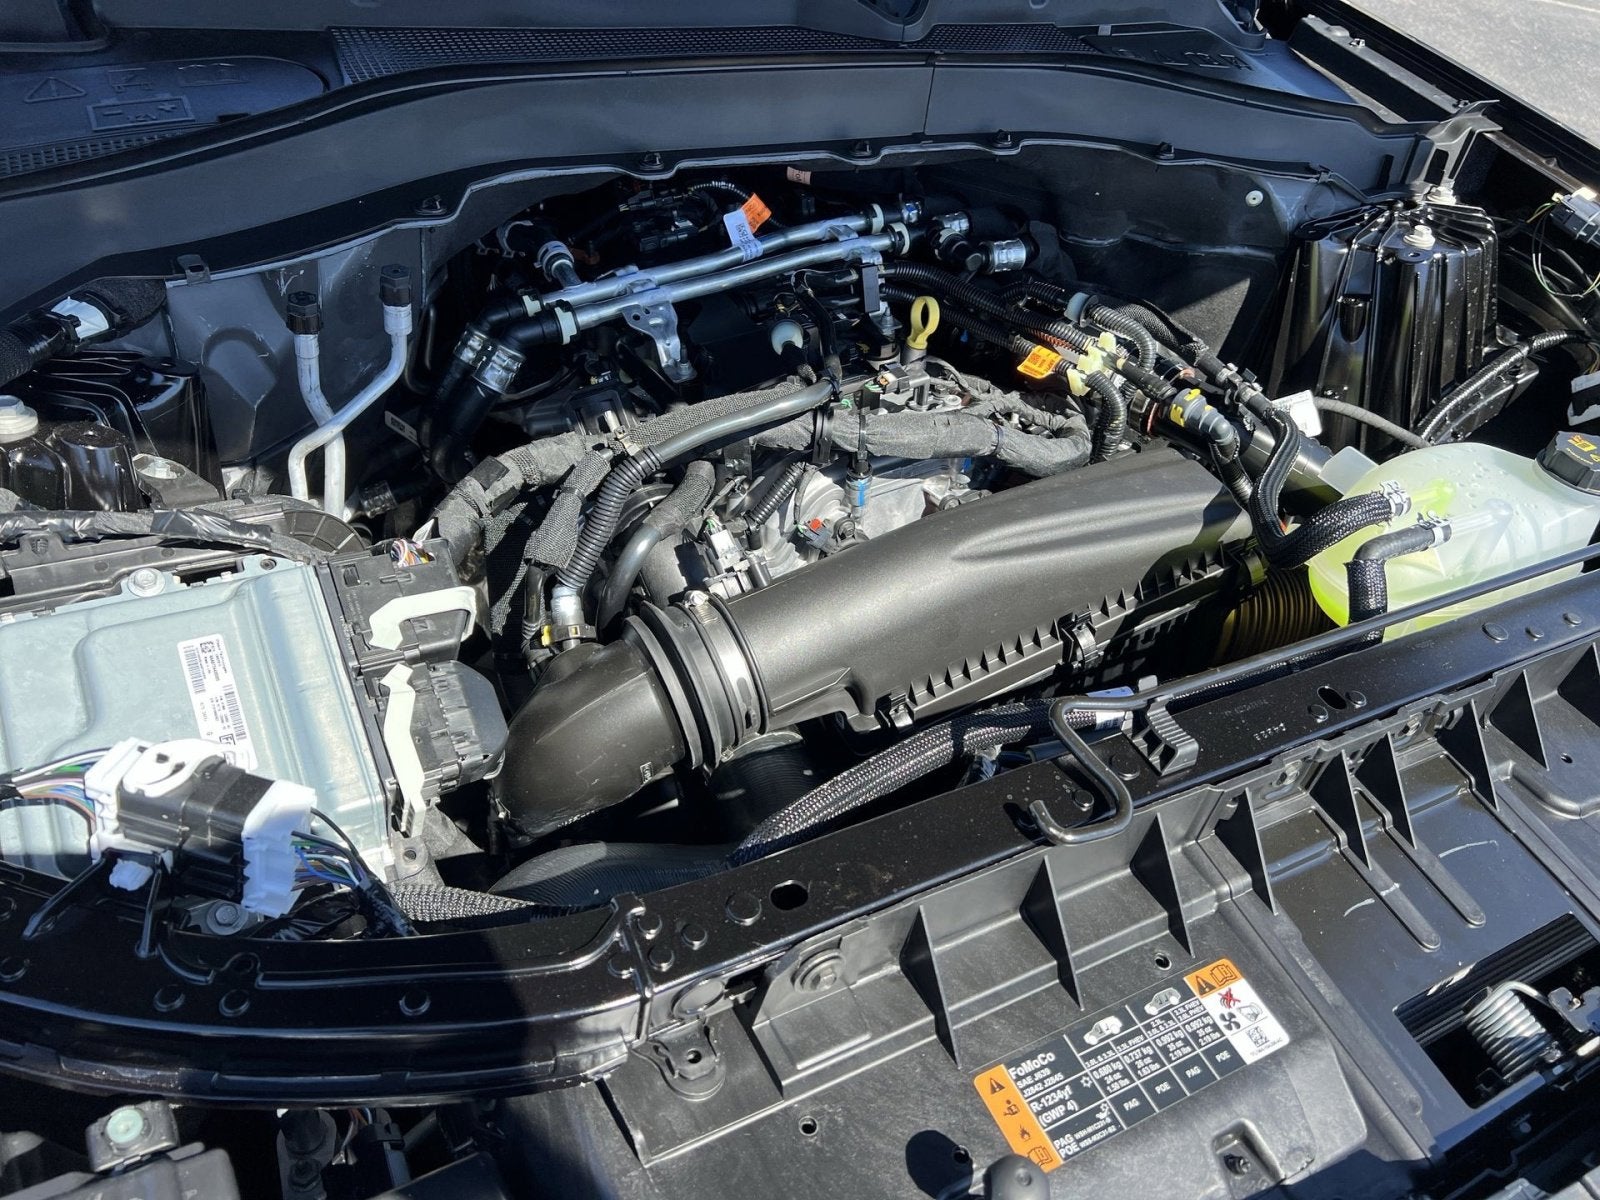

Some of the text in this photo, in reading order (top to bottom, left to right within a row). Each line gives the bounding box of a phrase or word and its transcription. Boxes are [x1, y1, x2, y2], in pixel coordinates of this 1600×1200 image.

[1185, 1016, 1214, 1032] 0.992 kg
[1155, 1030, 1185, 1047] 0.992 kg
[1196, 1028, 1205, 1037] 35
[1209, 1032, 1221, 1040] lbs
[1167, 1043, 1176, 1051] 35
[1180, 1046, 1192, 1054] lbs
[1123, 1046, 1154, 1064] 0.737 kg
[1215, 1050, 1231, 1062] POE
[1008, 1052, 1055, 1080] FoMoCo
[1092, 1061, 1124, 1079] 0.680 kg
[1135, 1057, 1153, 1069] 26 oz
[1138, 1063, 1160, 1077] 1.63 lbs
[1017, 1068, 1051, 1088] SAE J639
[1104, 1072, 1122, 1084] 24 oz
[1185, 1066, 1201, 1078] PAG
[1023, 1072, 1064, 1097] J2842 J2845
[1118, 1078, 1130, 1087] lbs
[1155, 1082, 1171, 1094] POE
[1030, 1085, 1072, 1113] R-1234yf
[1123, 1098, 1140, 1111] PAG
[1039, 1100, 1079, 1127] (GWP 4)
[1053, 1134, 1074, 1149] PAG
[1059, 1142, 1080, 1158] POE
